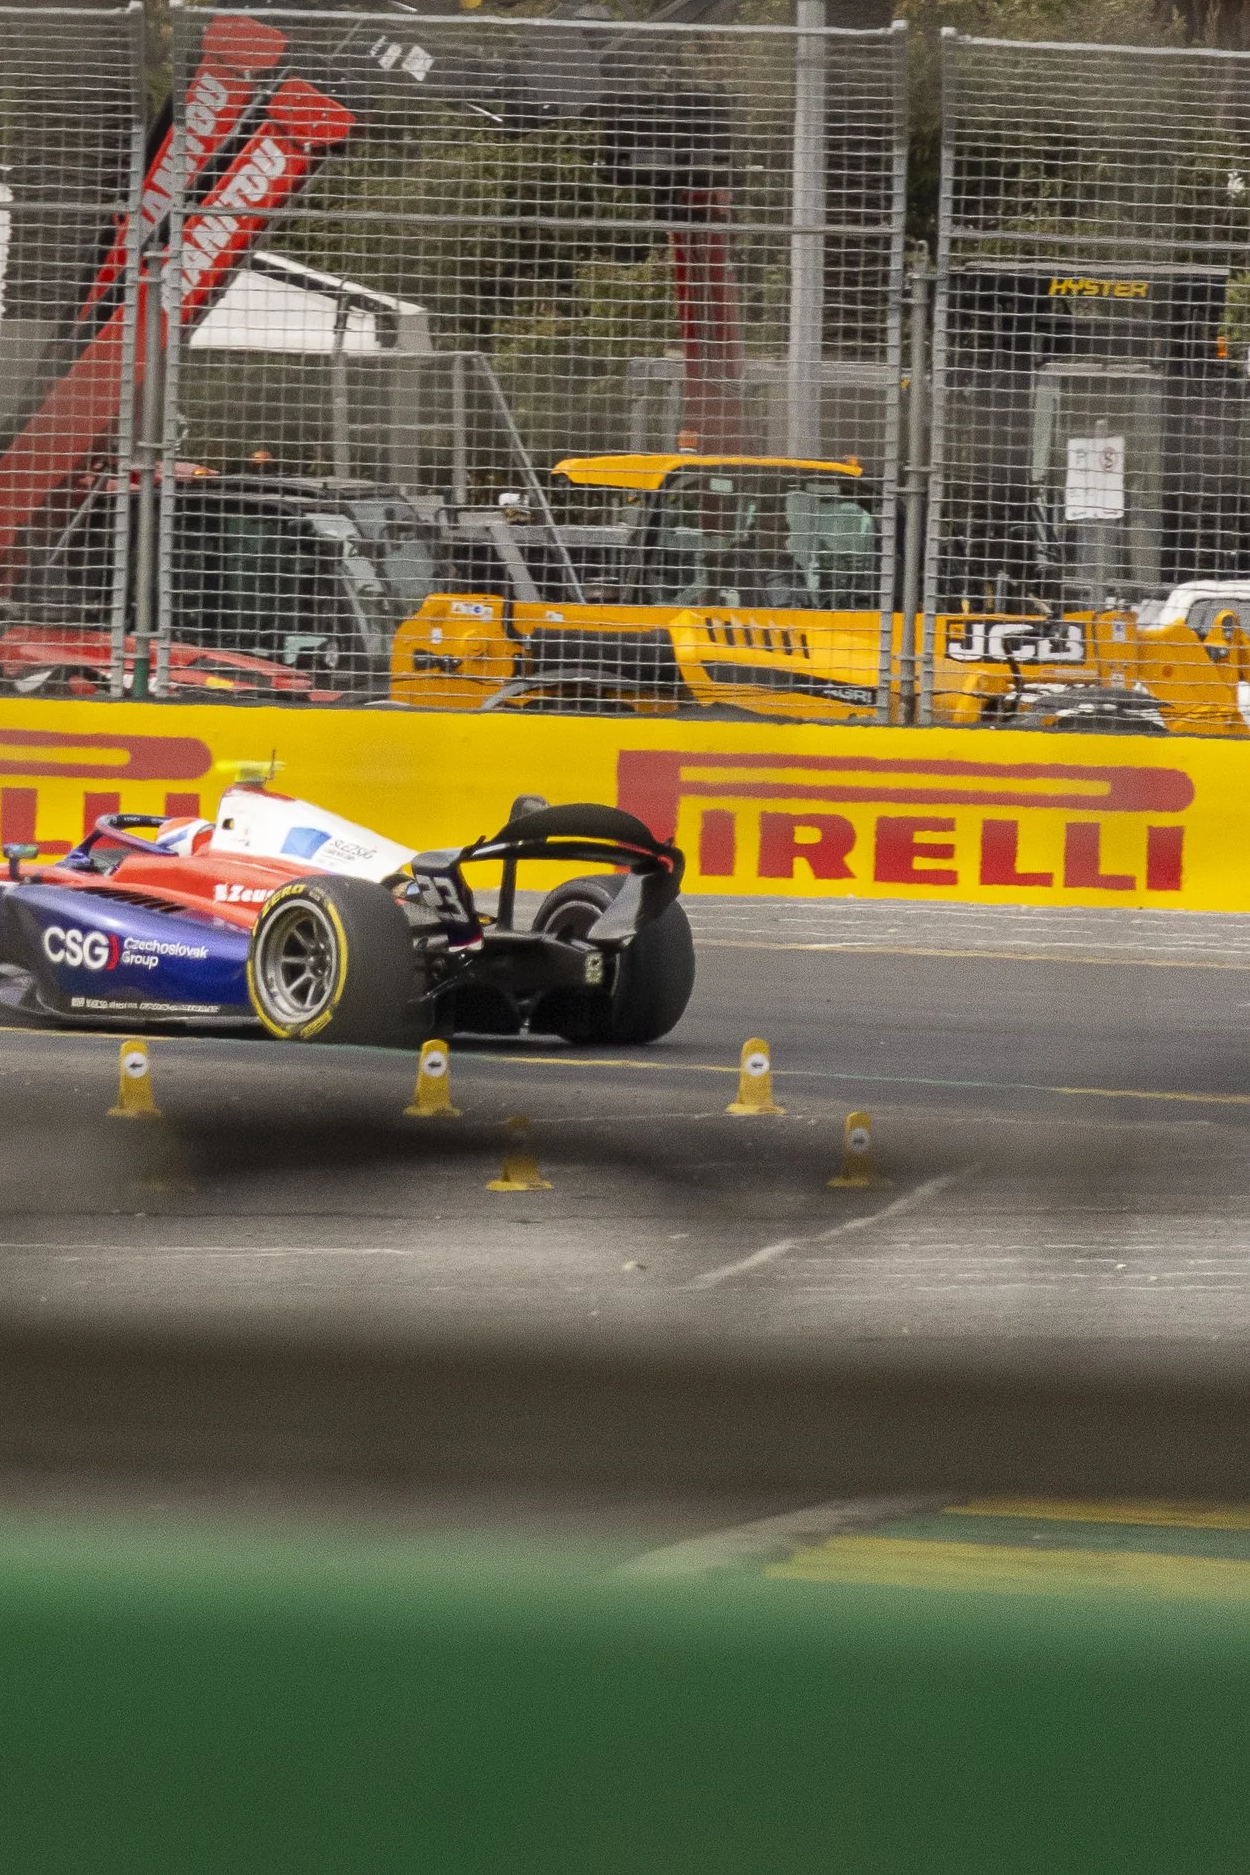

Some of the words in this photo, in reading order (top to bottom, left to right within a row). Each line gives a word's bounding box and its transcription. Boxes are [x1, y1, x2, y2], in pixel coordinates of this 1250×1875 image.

[1049, 277, 1148, 298] HYSTER
[948, 624, 1084, 661] JCB
[617, 750, 1195, 891] PIRELLI
[124, 936, 209, 959] Czechoslovak
[123, 950, 159, 969] Group
